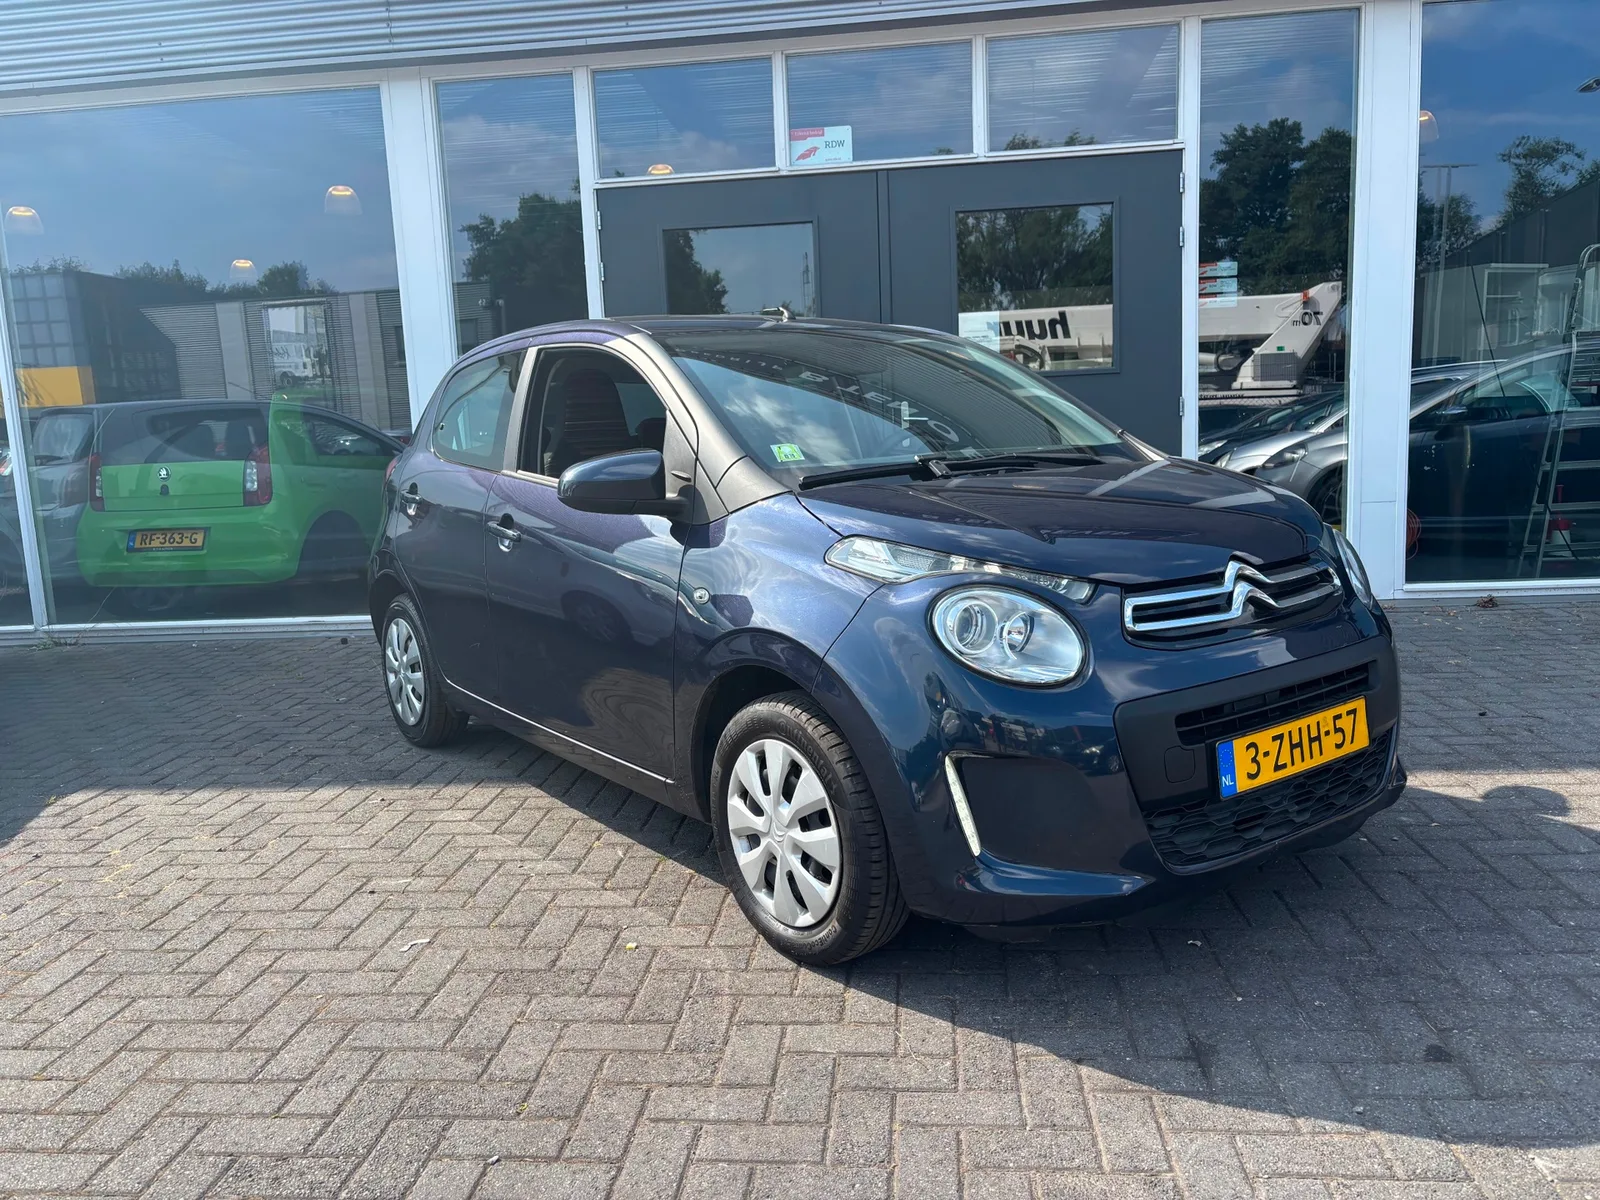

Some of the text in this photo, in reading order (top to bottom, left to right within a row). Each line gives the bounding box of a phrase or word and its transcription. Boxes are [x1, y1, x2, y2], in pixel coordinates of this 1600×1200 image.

[824, 139, 845, 149] RDW
[140, 532, 198, 546] RF-363-G
[1221, 707, 1358, 788] NL 3-ZHH-57
